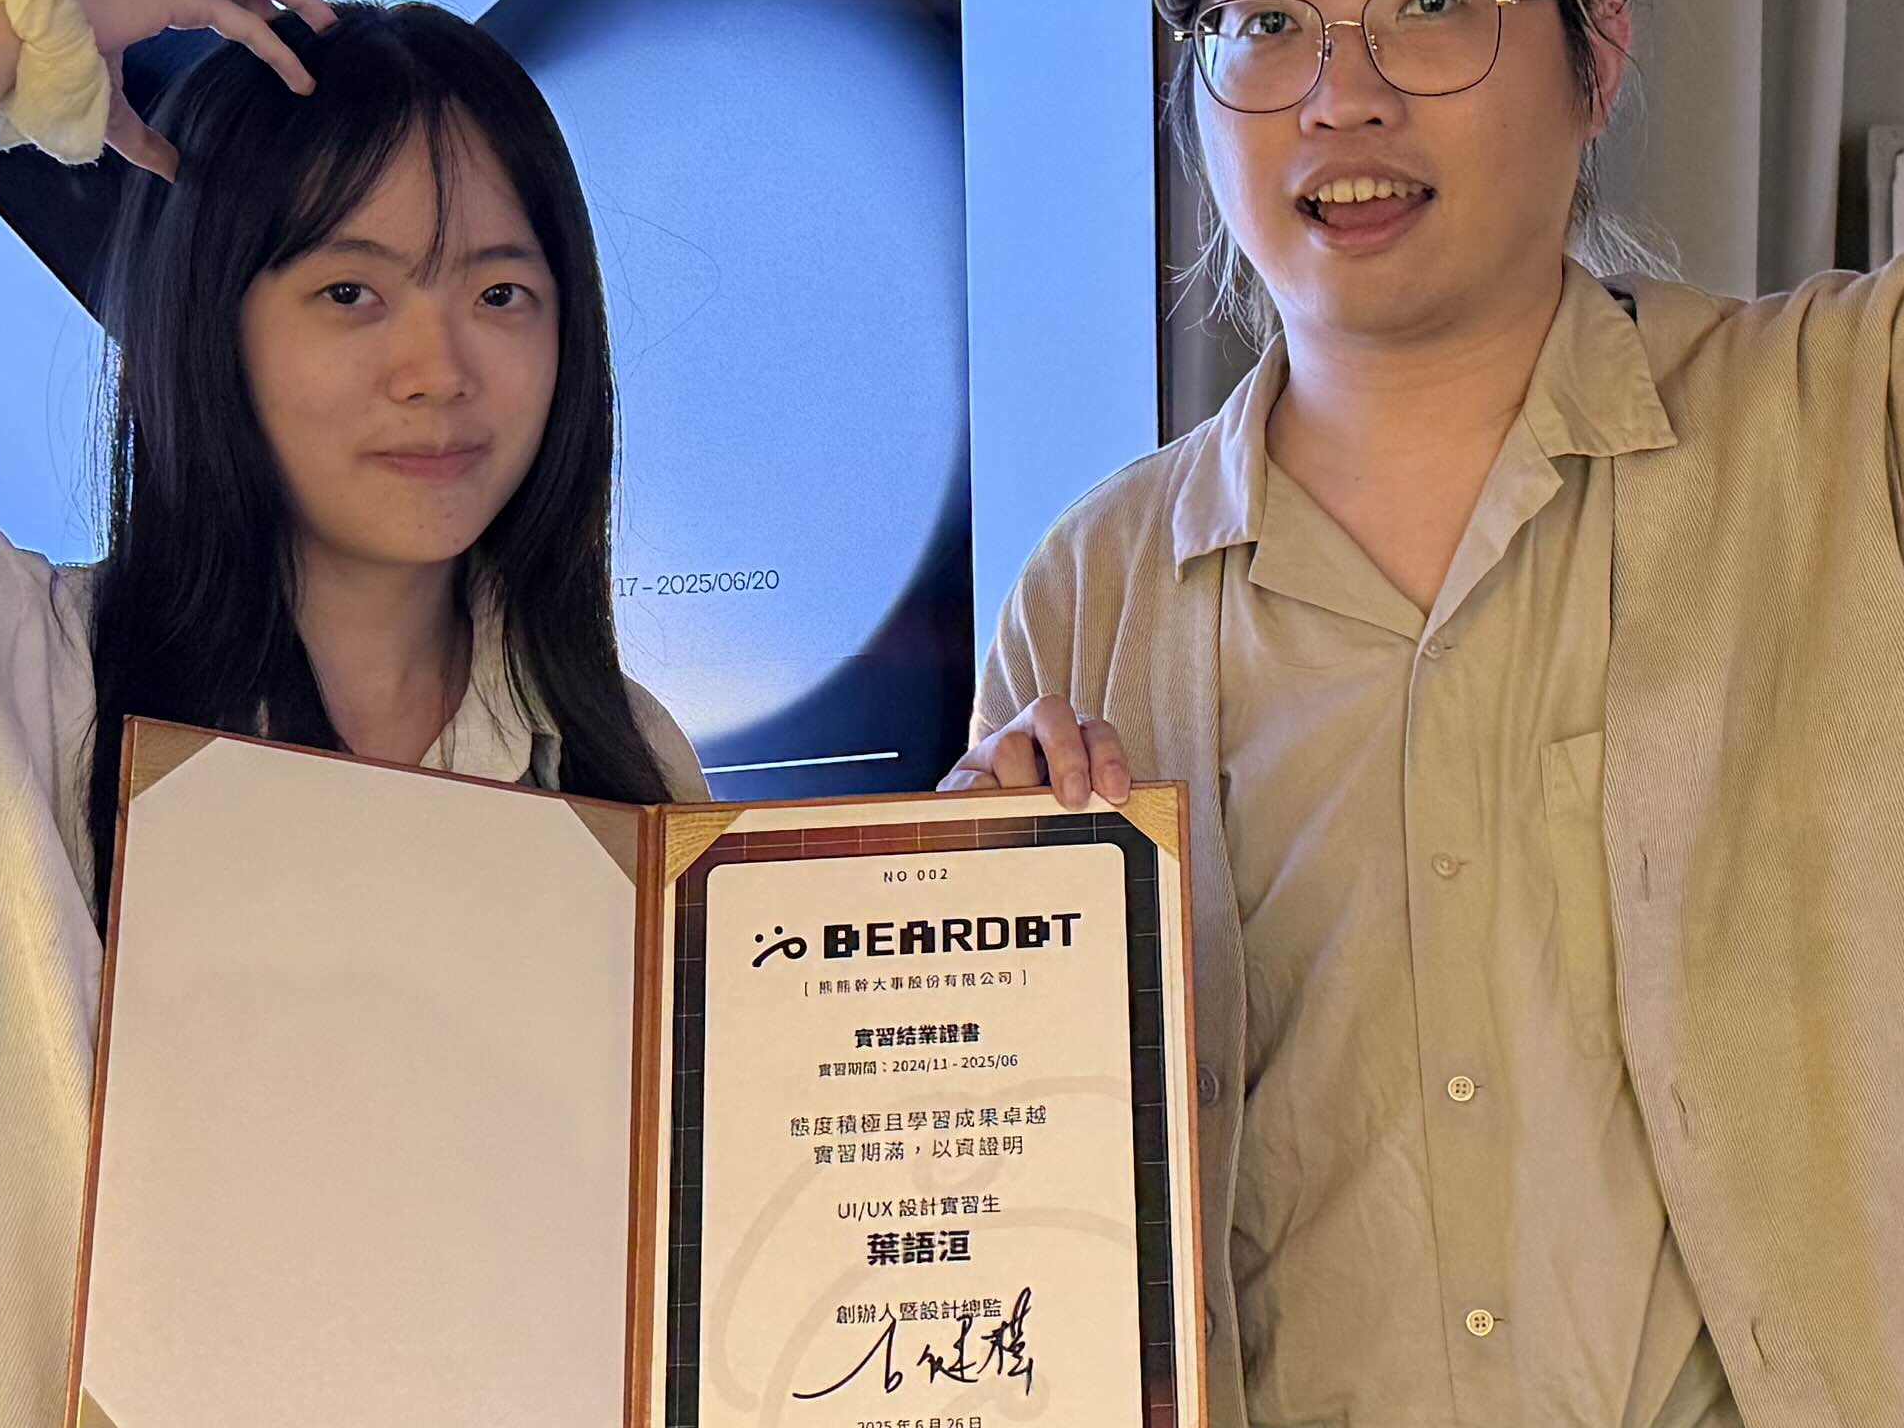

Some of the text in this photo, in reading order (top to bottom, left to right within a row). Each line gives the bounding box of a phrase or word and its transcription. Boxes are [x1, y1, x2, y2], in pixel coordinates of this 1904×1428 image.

[656, 569, 780, 596] 2025/06/20
[883, 868, 950, 883] NO 002
[823, 912, 1082, 960] BEARDBT
[854, 1022, 981, 1049] 實習結業證書
[789, 1105, 1047, 1138] 態度積極且學習成果卓越
[813, 1135, 1024, 1166] 實習期滿，以資證明
[837, 1194, 1002, 1221] UI/UX 設計實習生
[866, 1229, 972, 1266] 葉語洹
